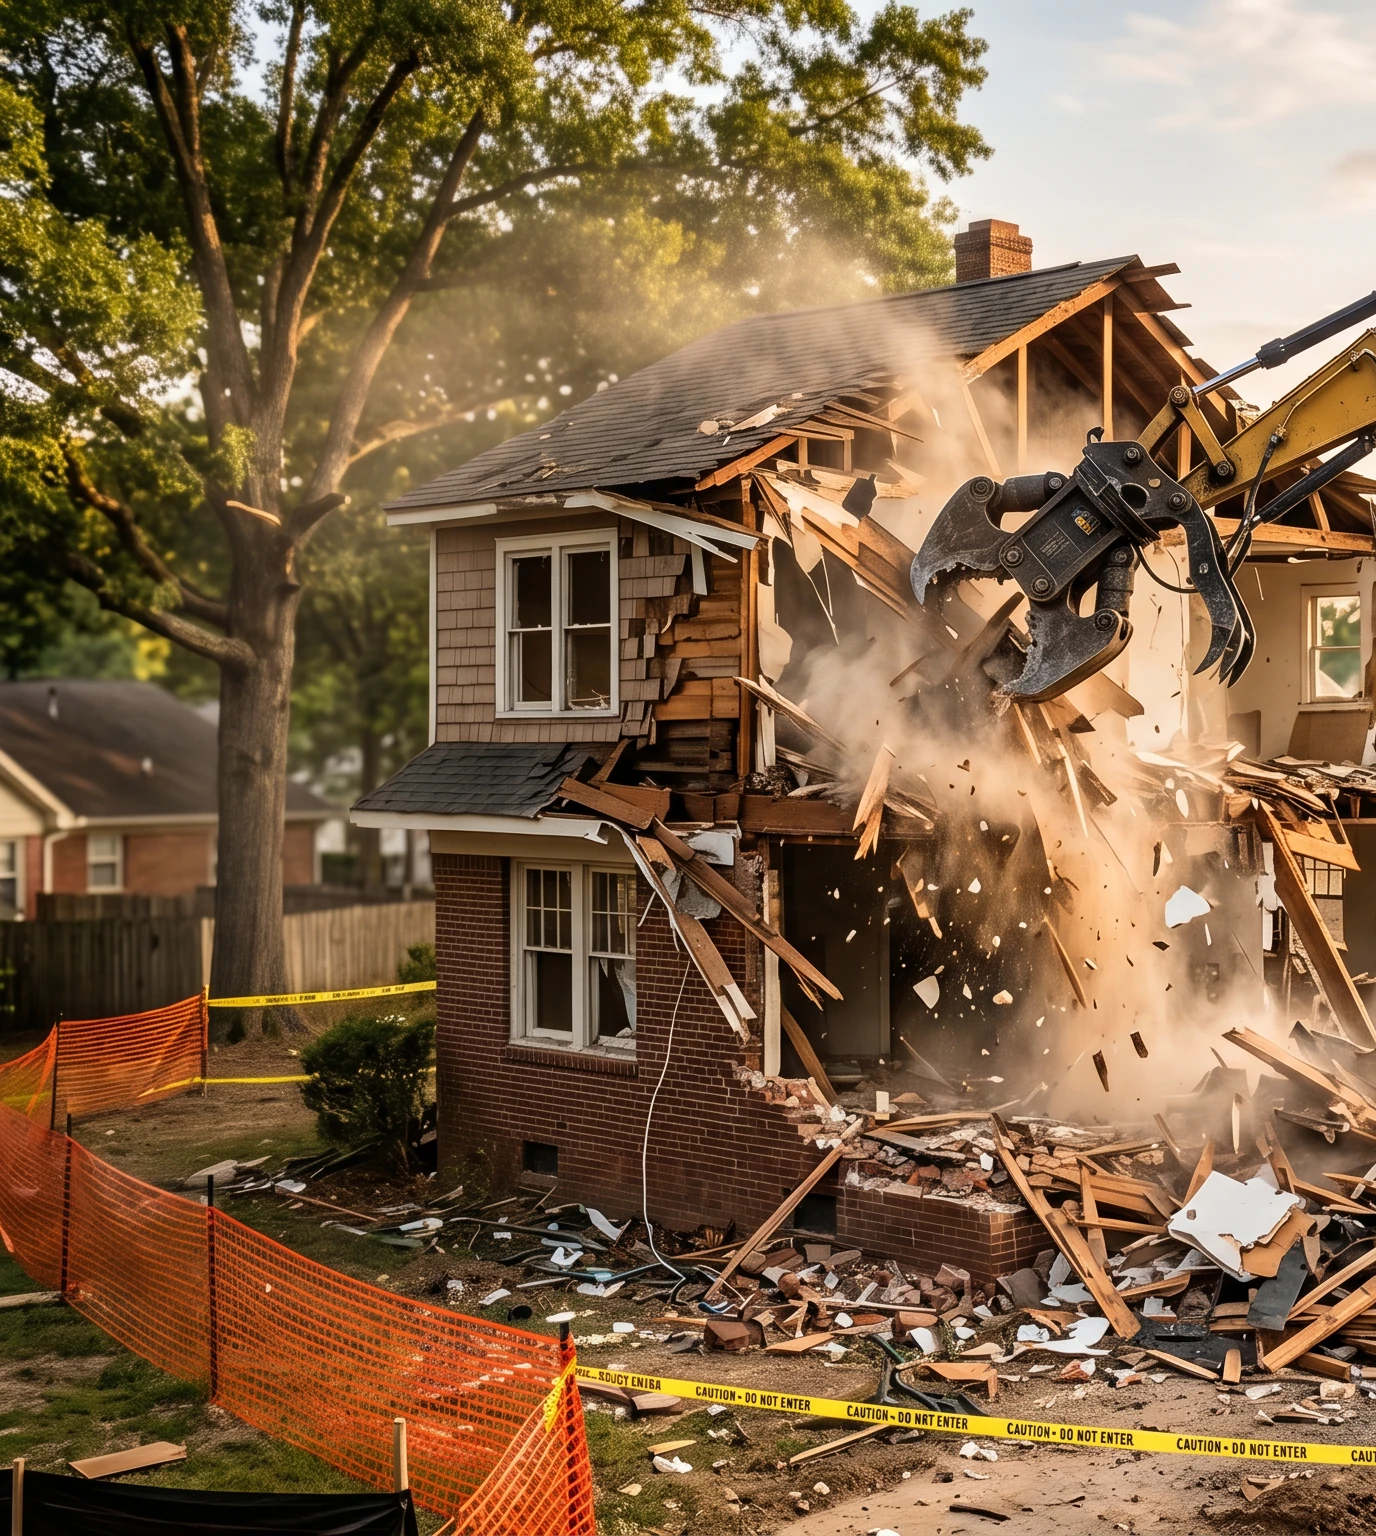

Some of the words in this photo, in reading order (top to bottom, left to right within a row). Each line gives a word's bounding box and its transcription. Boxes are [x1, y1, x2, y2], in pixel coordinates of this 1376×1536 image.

[695, 1386, 736, 1402] CAUTION
[745, 1392, 757, 1404] DO
[760, 1394, 779, 1407] NOT
[780, 1396, 811, 1412] ENTER
[898, 1411, 912, 1424] DO
[936, 1415, 968, 1430] ENTER
[1006, 1422, 1051, 1439] CAUTION
[1059, 1428, 1074, 1441] DO
[1076, 1429, 1098, 1443] NOT
[1100, 1431, 1134, 1446] ENTER
[1176, 1437, 1222, 1453] CAUTION
[1232, 1442, 1246, 1455] DO
[1249, 1443, 1271, 1457] NOT
[1273, 1444, 1308, 1459] ENTER
